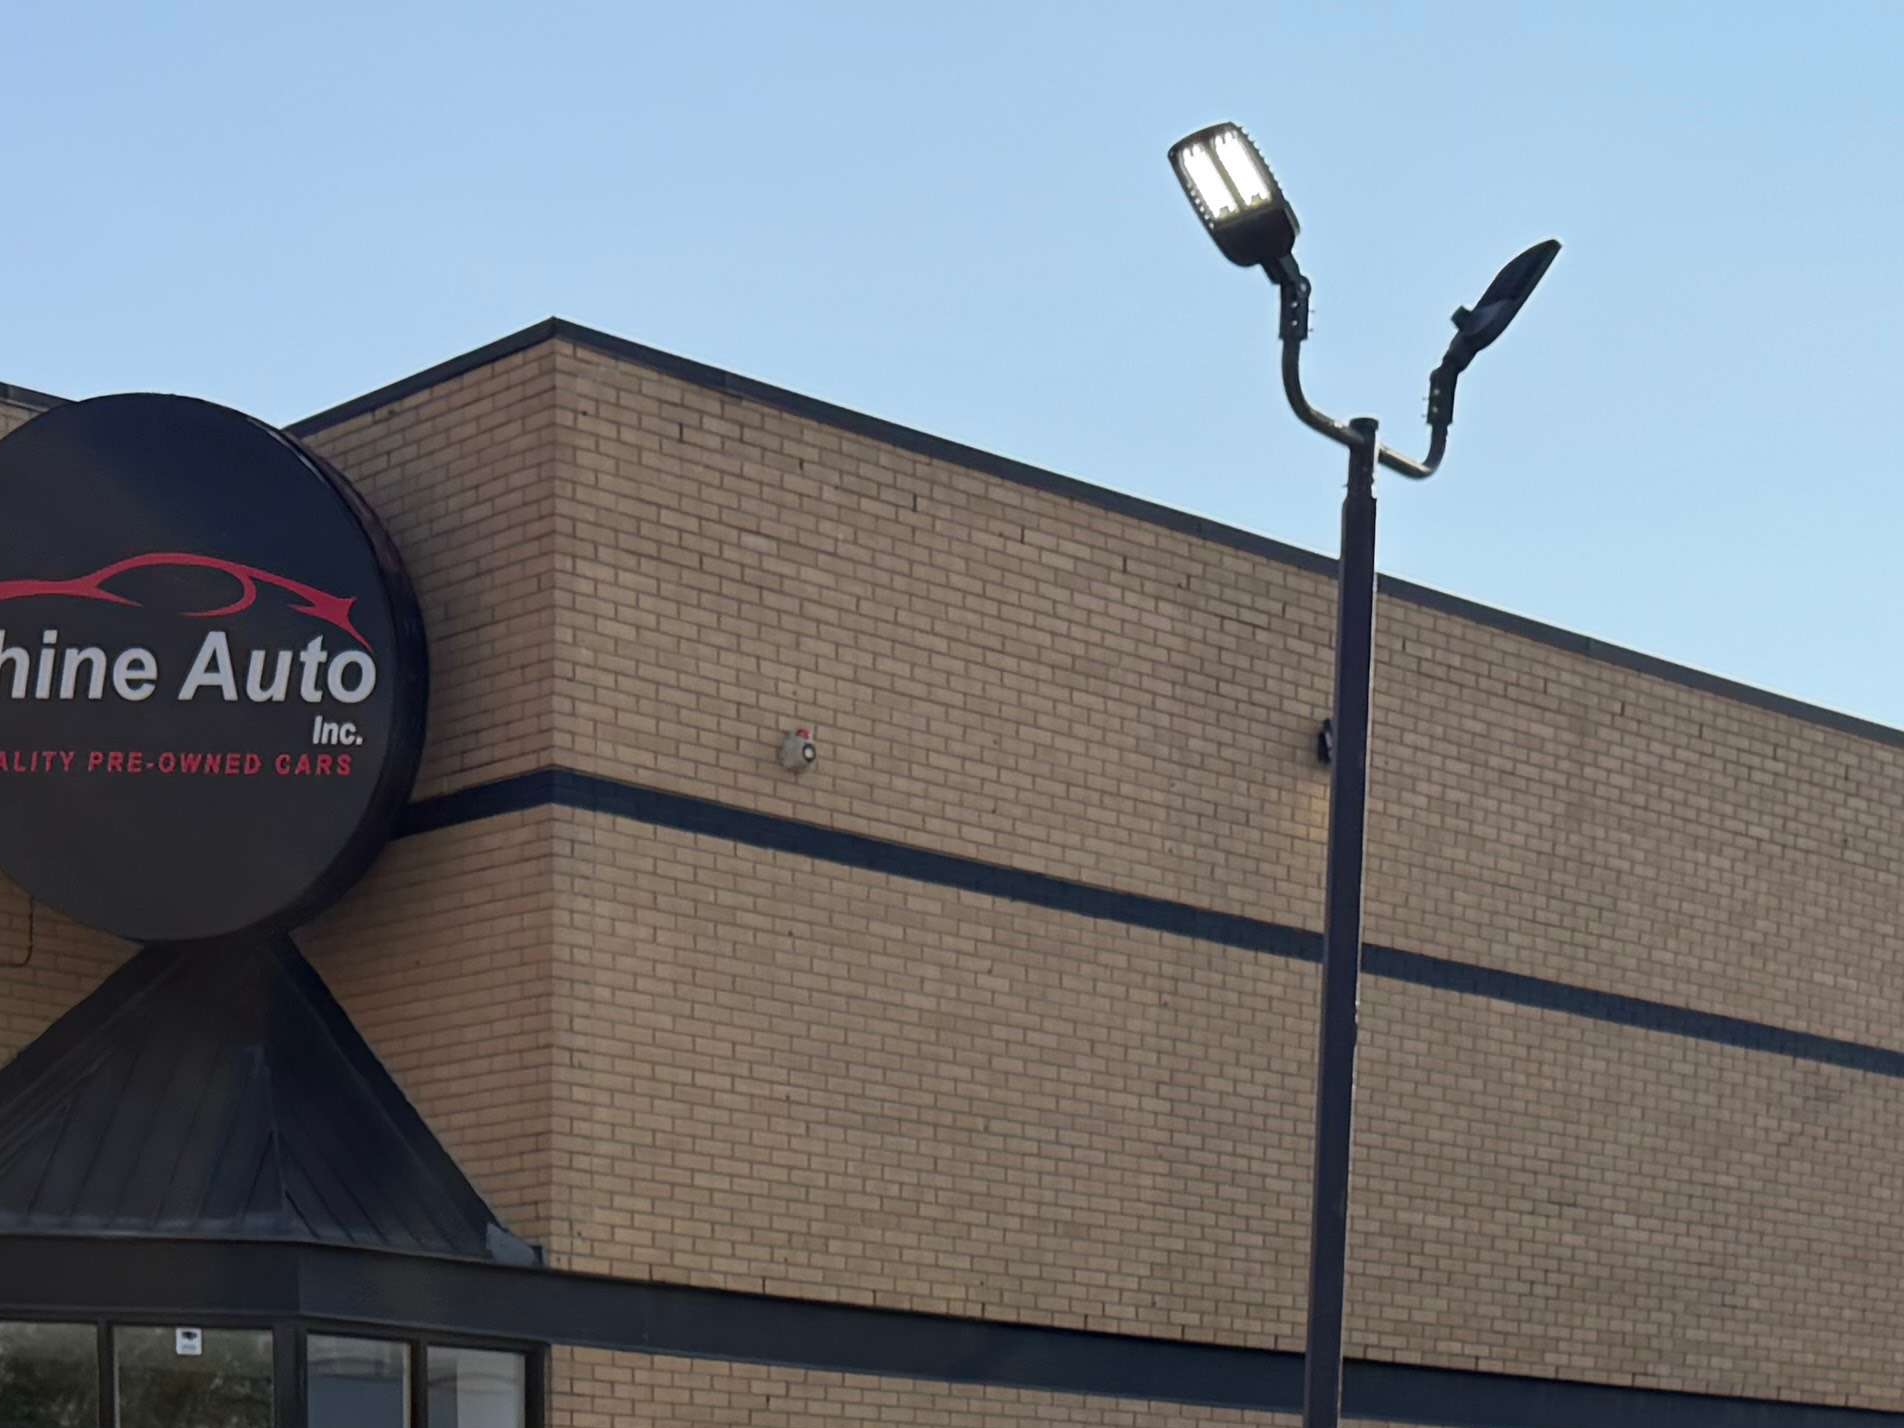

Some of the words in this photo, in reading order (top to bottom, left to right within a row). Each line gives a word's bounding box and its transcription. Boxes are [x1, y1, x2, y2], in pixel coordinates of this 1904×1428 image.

[178, 631, 377, 704] Auto
[311, 715, 364, 746] Inc.
[88, 751, 262, 775] PRE-OWNED
[275, 753, 353, 777] CARS
